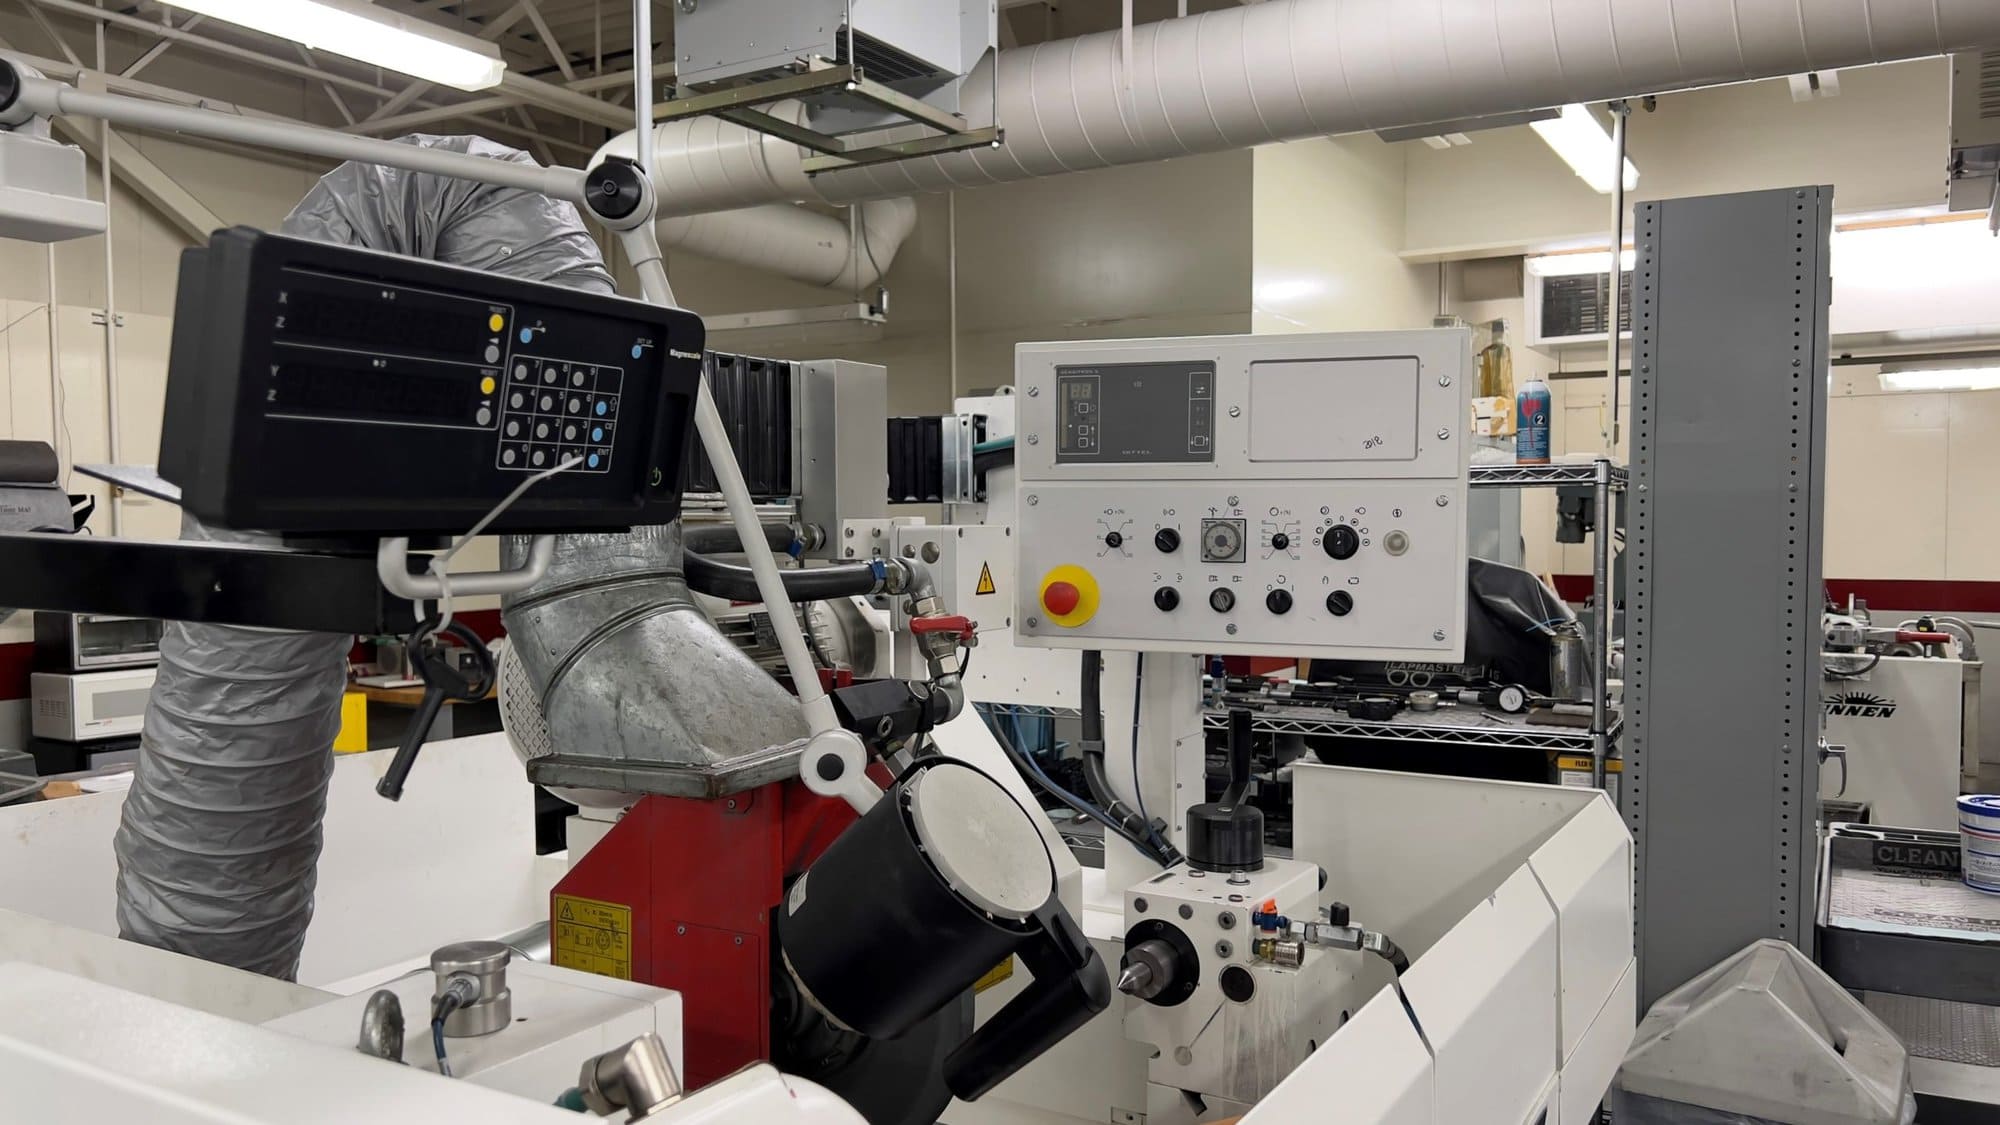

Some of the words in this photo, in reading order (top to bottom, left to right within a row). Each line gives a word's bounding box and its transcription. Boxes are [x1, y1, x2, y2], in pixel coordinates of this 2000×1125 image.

[279, 291, 288, 304] X
[275, 316, 286, 328] Z
[271, 365, 279, 376] Y
[267, 389, 277, 401] Z
[1537, 415, 1544, 425] 2
[1826, 704, 1897, 718] NNEN
[1877, 846, 1959, 867] CLEAN
